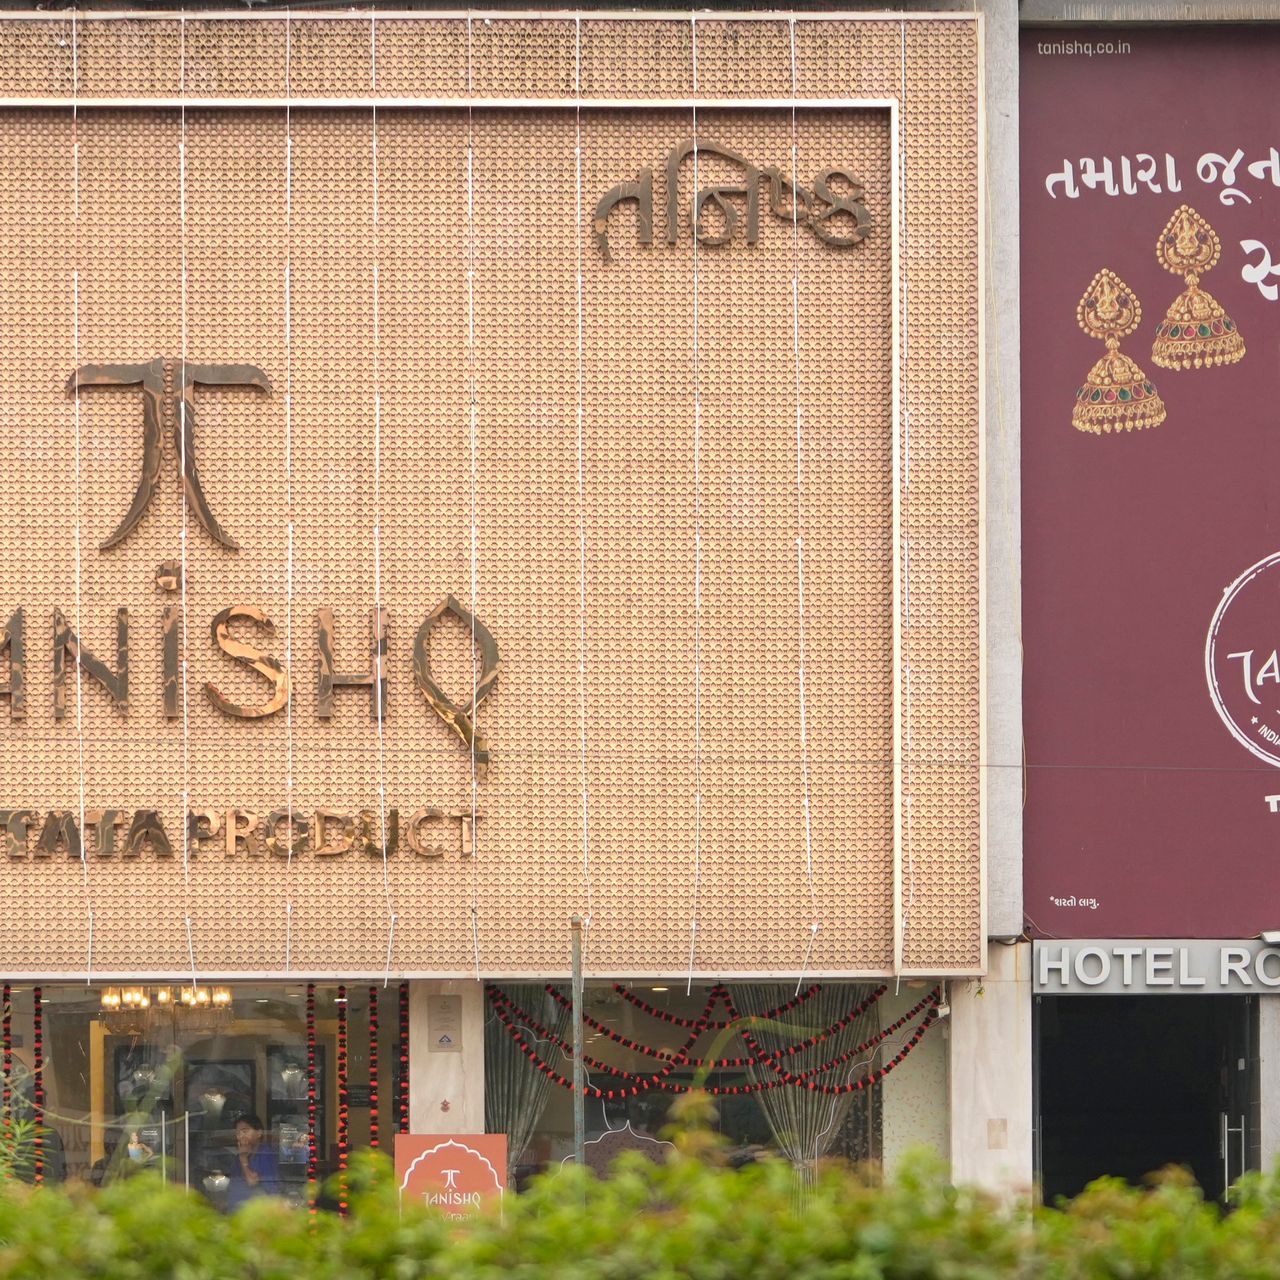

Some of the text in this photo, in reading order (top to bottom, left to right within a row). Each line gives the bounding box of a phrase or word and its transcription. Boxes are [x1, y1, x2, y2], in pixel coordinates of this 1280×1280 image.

[1037, 40, 1131, 57] tanishq.co.in
[1045, 152, 1182, 199] તમારા
[186, 808, 484, 859] PRODUCT
[1037, 946, 1206, 986] HOTEL
